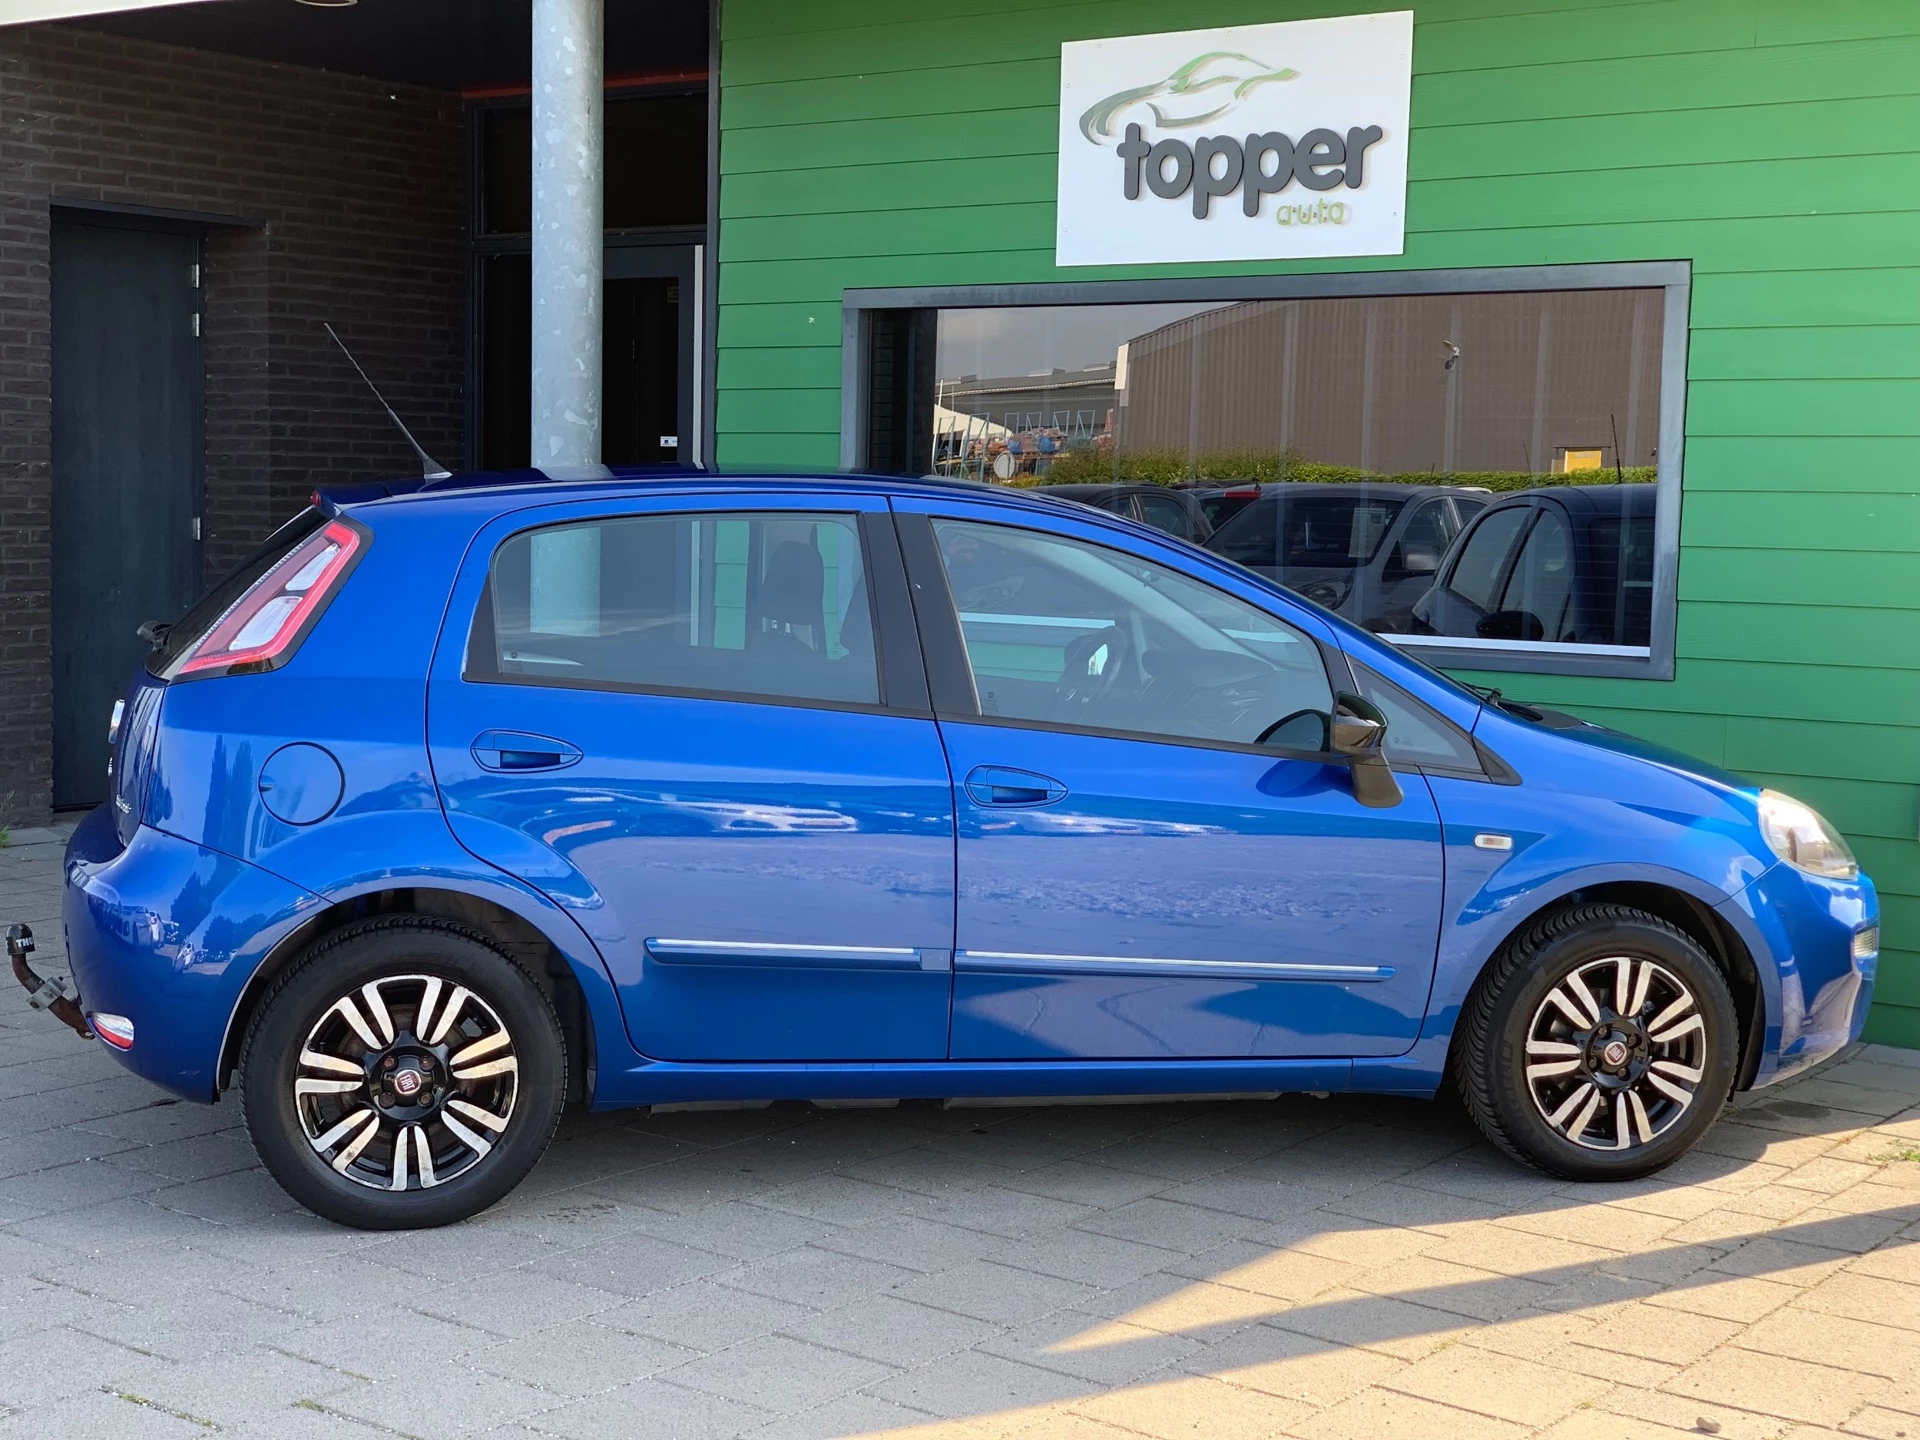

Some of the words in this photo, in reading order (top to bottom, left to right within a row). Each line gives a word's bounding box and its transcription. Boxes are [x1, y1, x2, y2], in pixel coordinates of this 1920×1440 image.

[1116, 122, 1383, 220] topper
[1275, 198, 1346, 226] auto
[399, 1073, 416, 1091] FIAT
